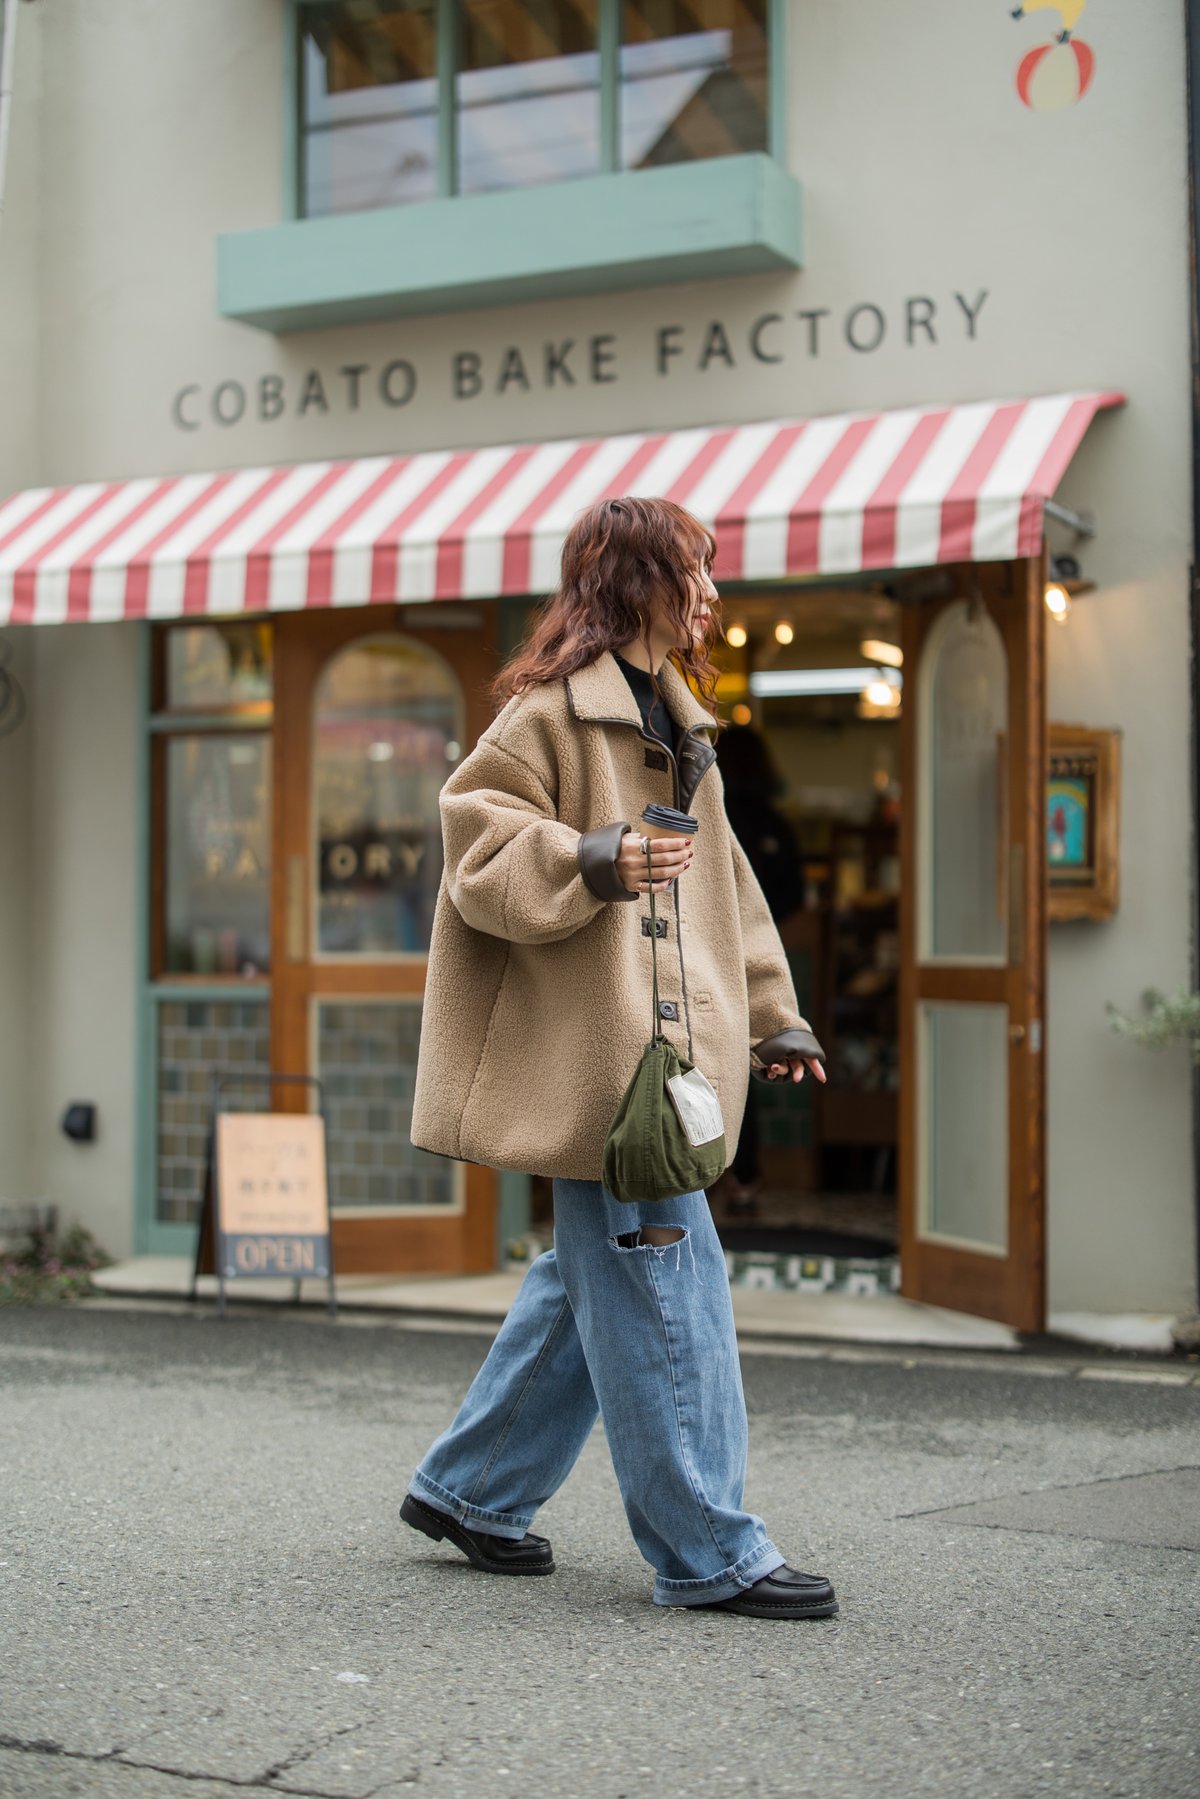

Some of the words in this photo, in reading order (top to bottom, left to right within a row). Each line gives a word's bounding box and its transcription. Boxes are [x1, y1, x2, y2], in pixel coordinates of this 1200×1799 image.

[173, 359, 418, 431] COBATO
[453, 334, 618, 400] BAKE
[656, 290, 989, 376] FACTORY
[235, 1238, 315, 1272] OPEN
